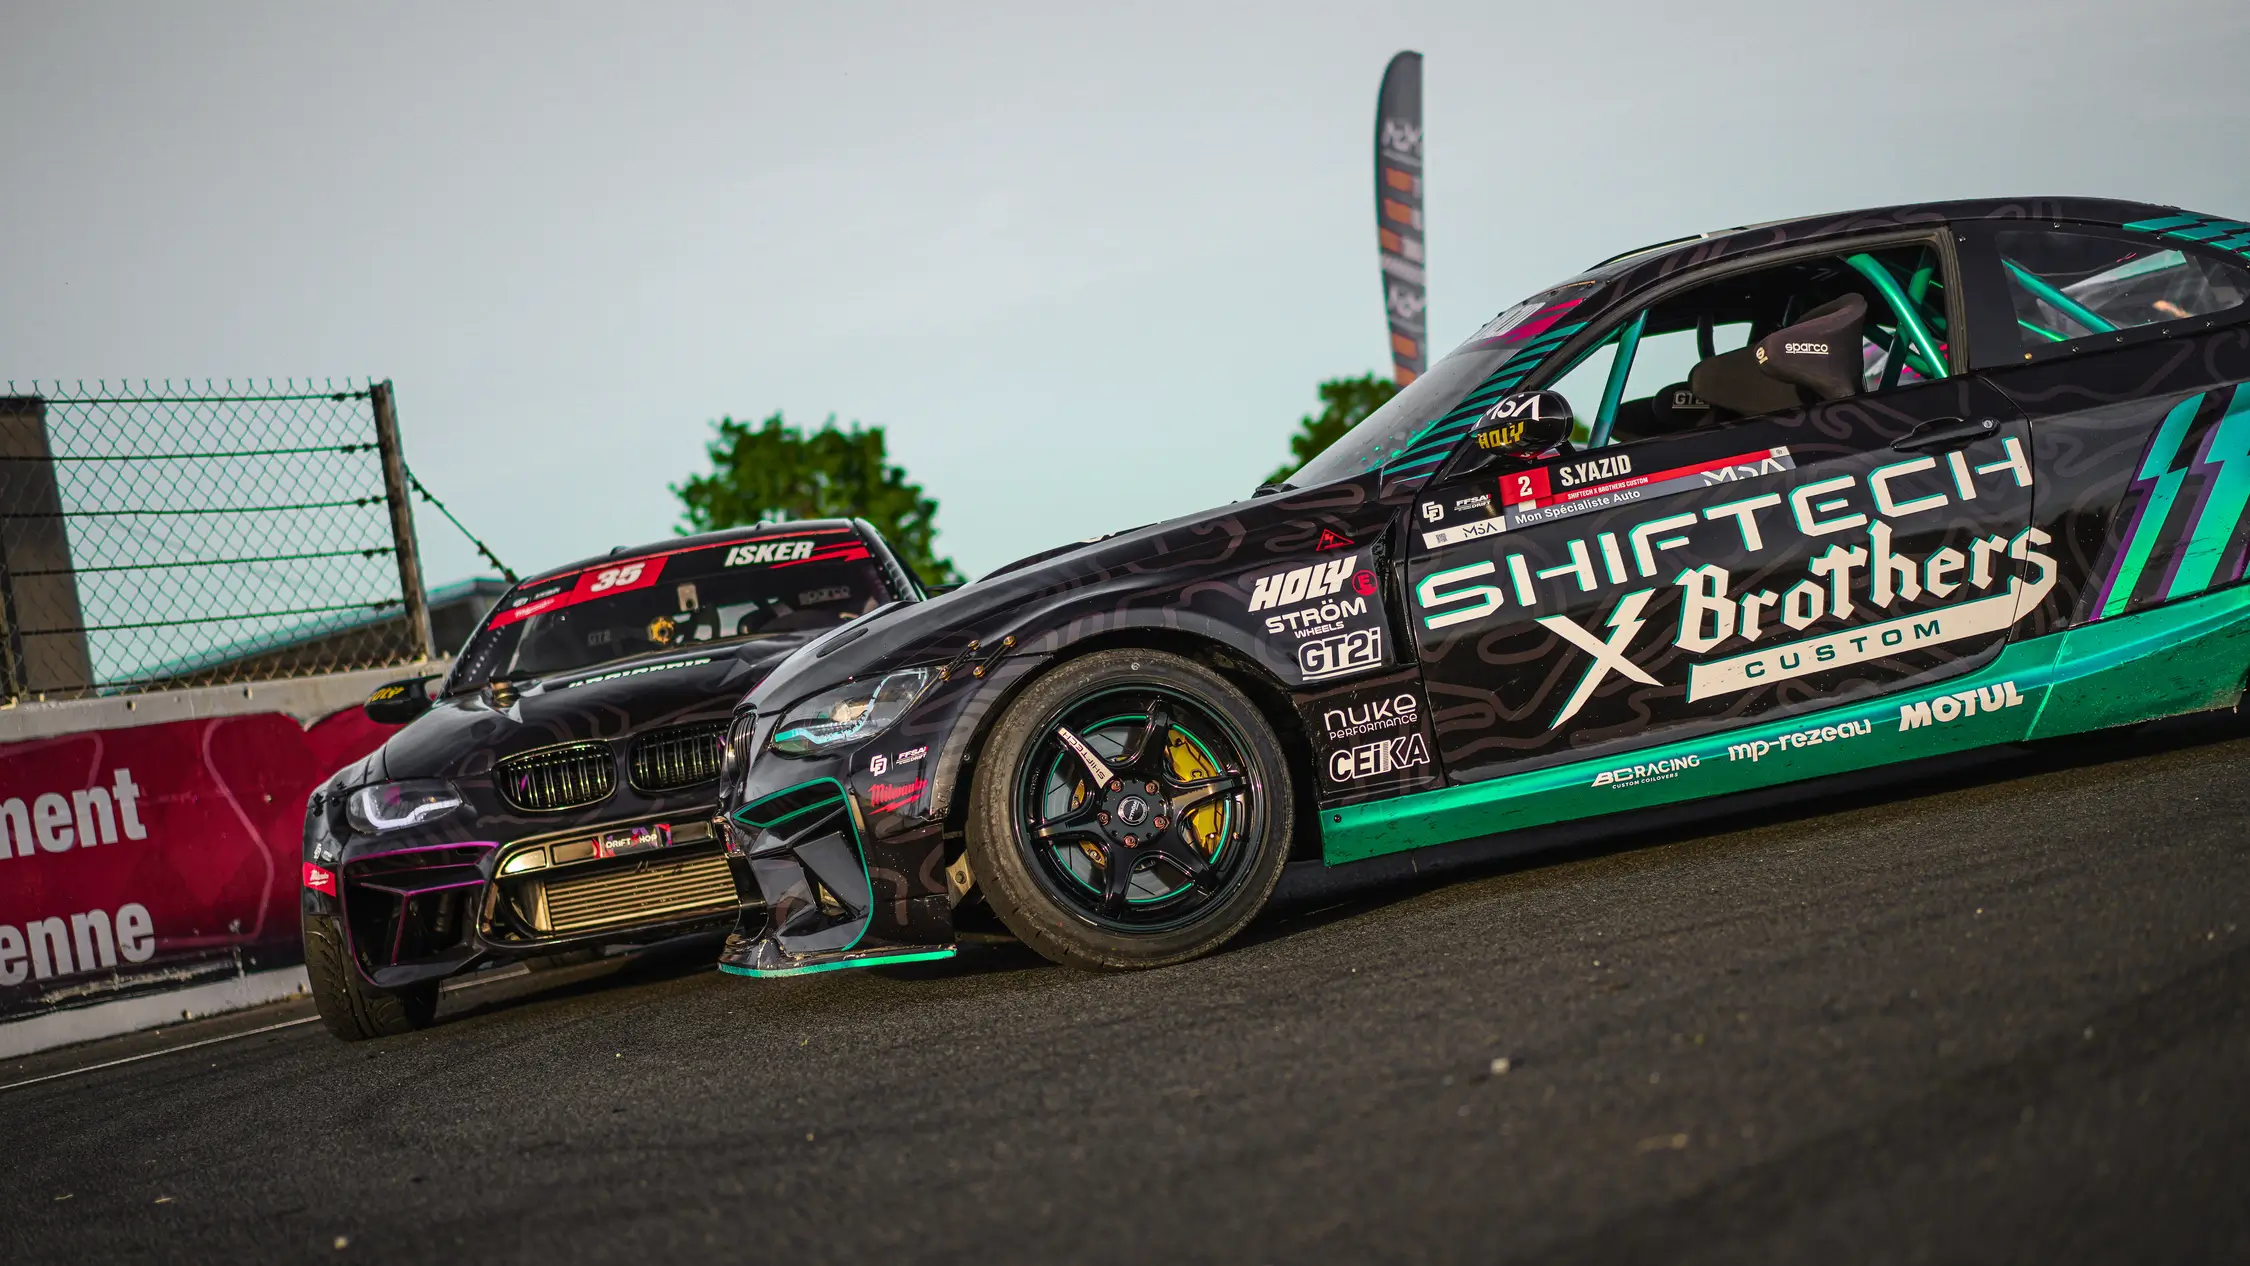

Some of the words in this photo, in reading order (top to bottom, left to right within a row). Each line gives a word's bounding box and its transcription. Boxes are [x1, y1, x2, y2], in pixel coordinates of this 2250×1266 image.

[1785, 343, 1829, 354] sparco
[1518, 476, 1533, 497] 2
[1560, 455, 1632, 487] S.YAZID
[1568, 489, 1594, 500] SHIFTECH
[1626, 477, 1649, 487] CUSTOM
[1515, 512, 1542, 524] Mon
[1545, 498, 1611, 519] Spécialiste
[1613, 490, 1640, 503] Auto
[1416, 436, 2032, 630] SHIFTECH
[724, 541, 815, 567] ISKER
[590, 564, 644, 592] 35
[1248, 555, 1358, 612] HOLY
[1672, 518, 2057, 653] Brothers
[1265, 597, 1367, 634] STRÖM
[1295, 621, 1345, 639] WHEELS
[1744, 619, 1942, 679] CUSTOM
[1899, 681, 2024, 732] MOTUL
[1728, 718, 1872, 762] mp-rezeau
[1612, 780, 1640, 789] CUSTOM
[1640, 772, 1679, 784] COILOVERS
